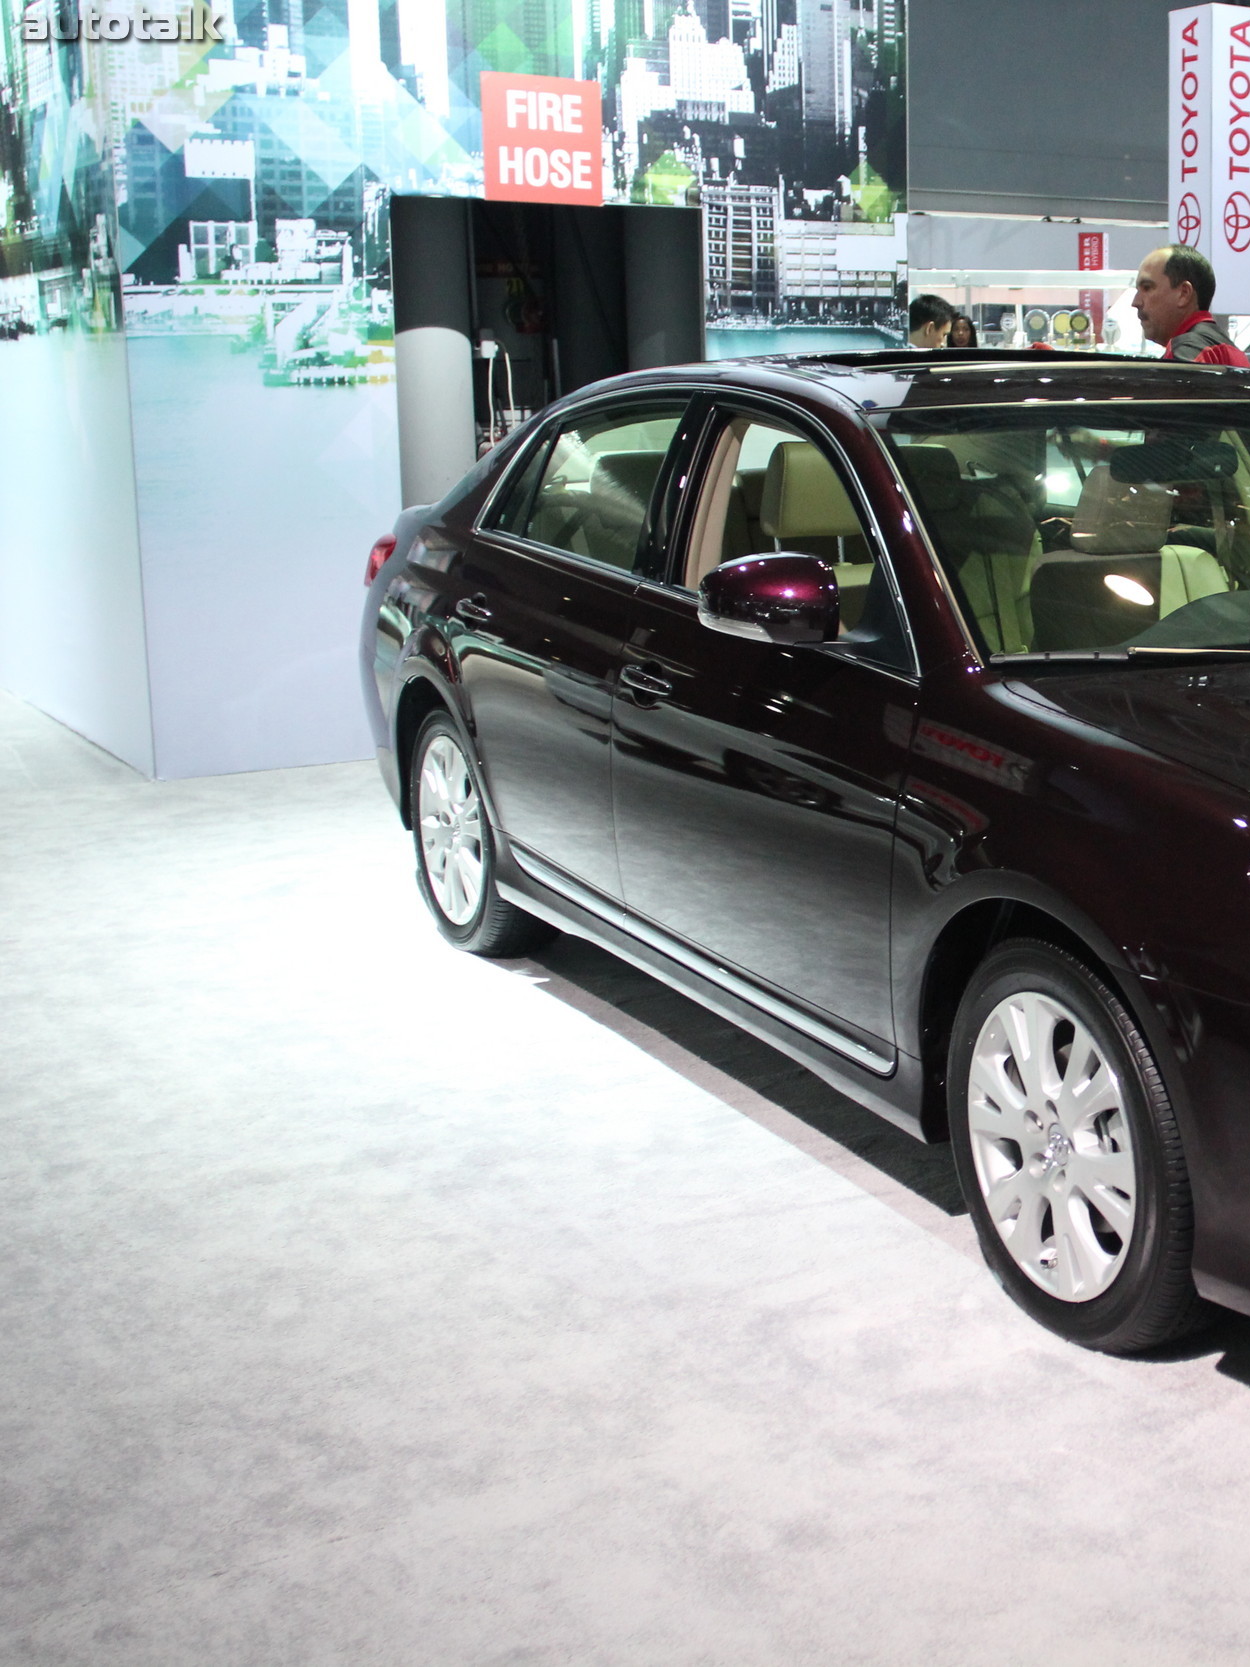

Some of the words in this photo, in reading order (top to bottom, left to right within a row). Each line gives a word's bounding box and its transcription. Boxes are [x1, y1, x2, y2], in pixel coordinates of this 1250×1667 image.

[506, 89, 583, 134] FIRE
[1181, 17, 1198, 183] TOYOTA
[498, 145, 593, 190] HOSE
